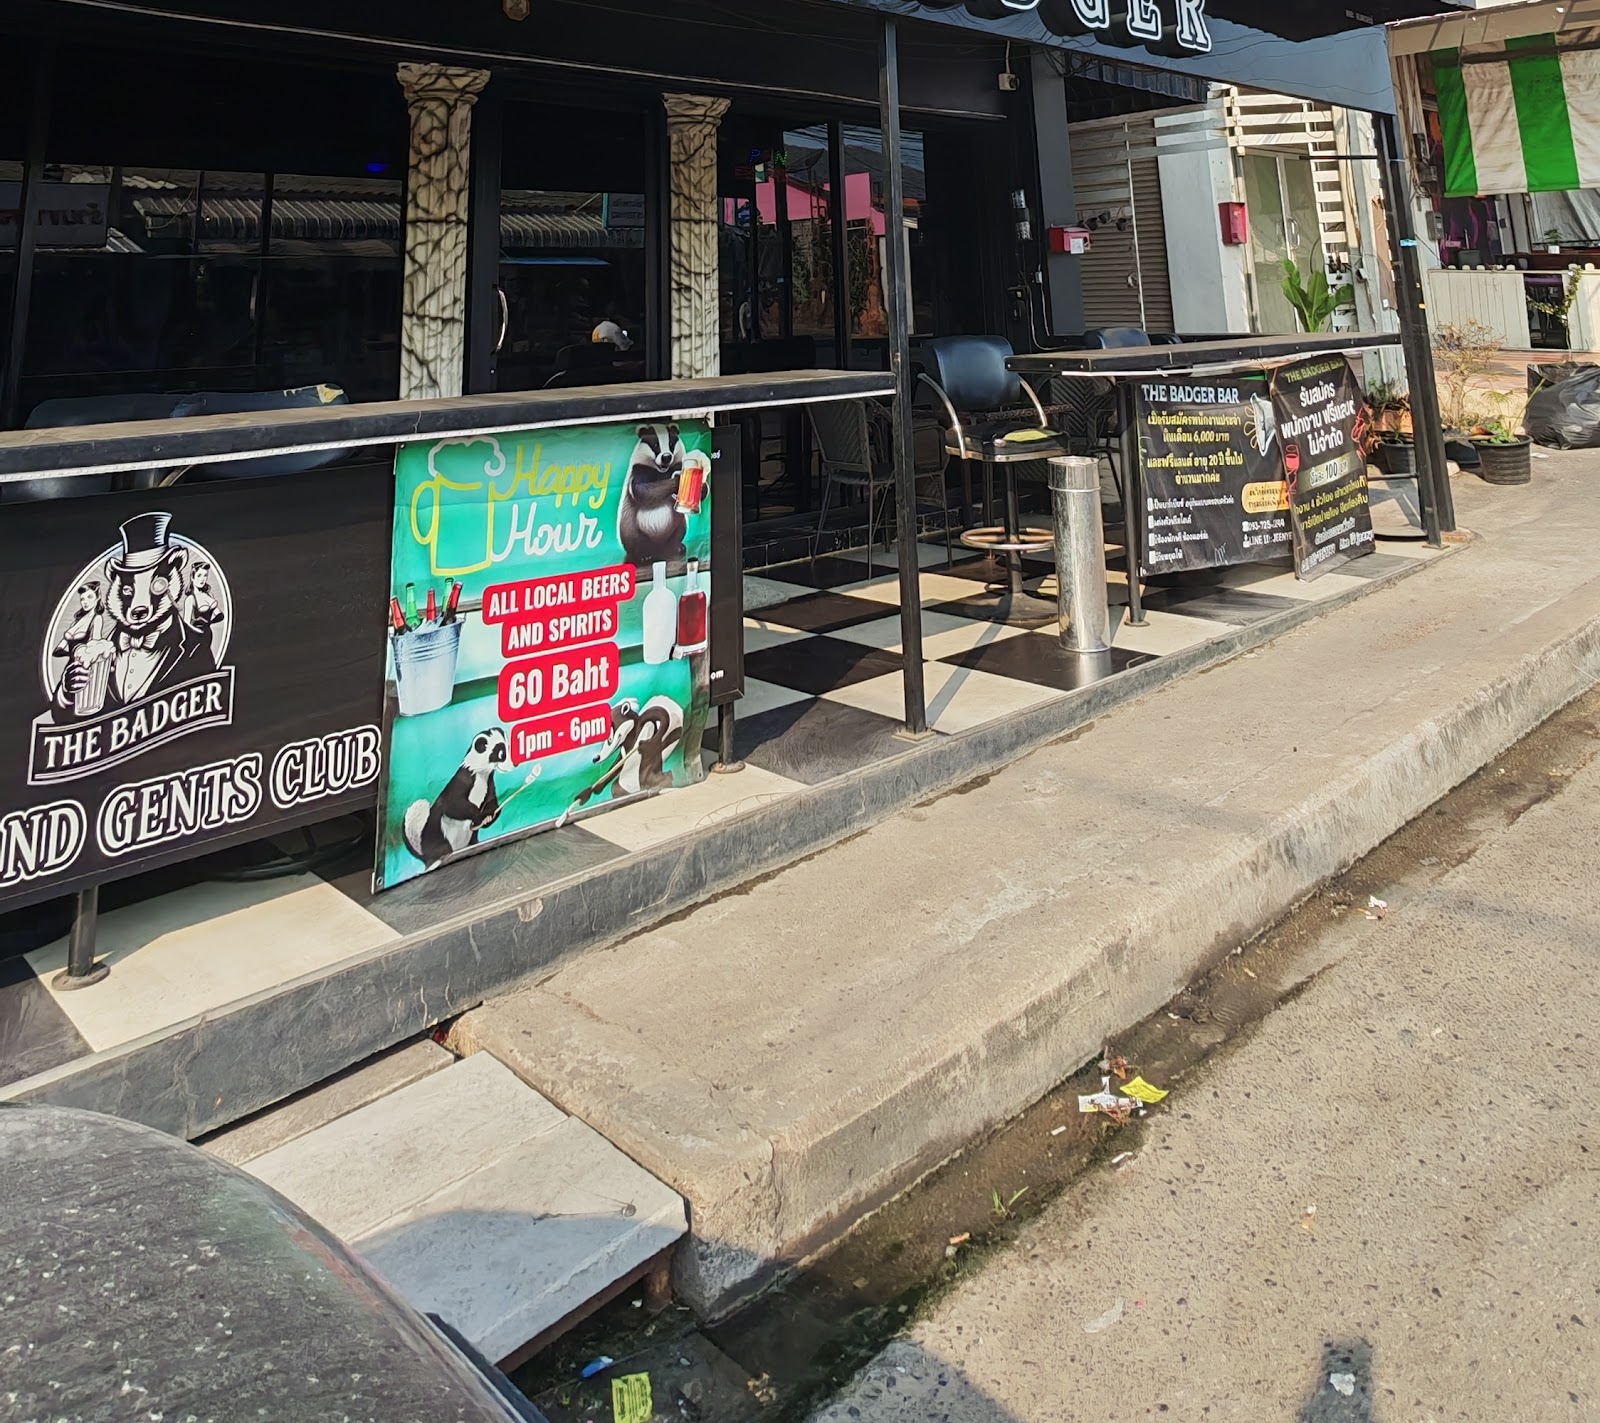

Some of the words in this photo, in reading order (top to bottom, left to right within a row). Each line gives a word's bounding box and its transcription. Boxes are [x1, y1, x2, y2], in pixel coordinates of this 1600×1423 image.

[1141, 384, 1168, 402] THE
[1169, 385, 1217, 404] BADGER
[1217, 387, 1240, 404] BAR
[1285, 370, 1302, 384] THE
[1301, 362, 1331, 379] BADGER
[1193, 430, 1216, 445] 6,000
[491, 442, 611, 510] Happy
[1208, 454, 1219, 467] 20
[1325, 461, 1338, 480] 100
[491, 501, 603, 563] Hour
[488, 589, 520, 618] ALL
[524, 579, 576, 611] LOCAL
[581, 571, 631, 602] BEERS
[507, 621, 544, 651] AND
[548, 608, 613, 643] SPIRITS
[508, 668, 544, 710] 60
[552, 656, 610, 701] Baht
[44, 729, 102, 769] THE
[109, 681, 224, 753] BADGER
[516, 729, 553, 759] 1pm
[570, 717, 606, 745] 6pm
[0, 798, 88, 888] ND
[97, 752, 263, 857] GENTS
[269, 724, 382, 809] CLUB
